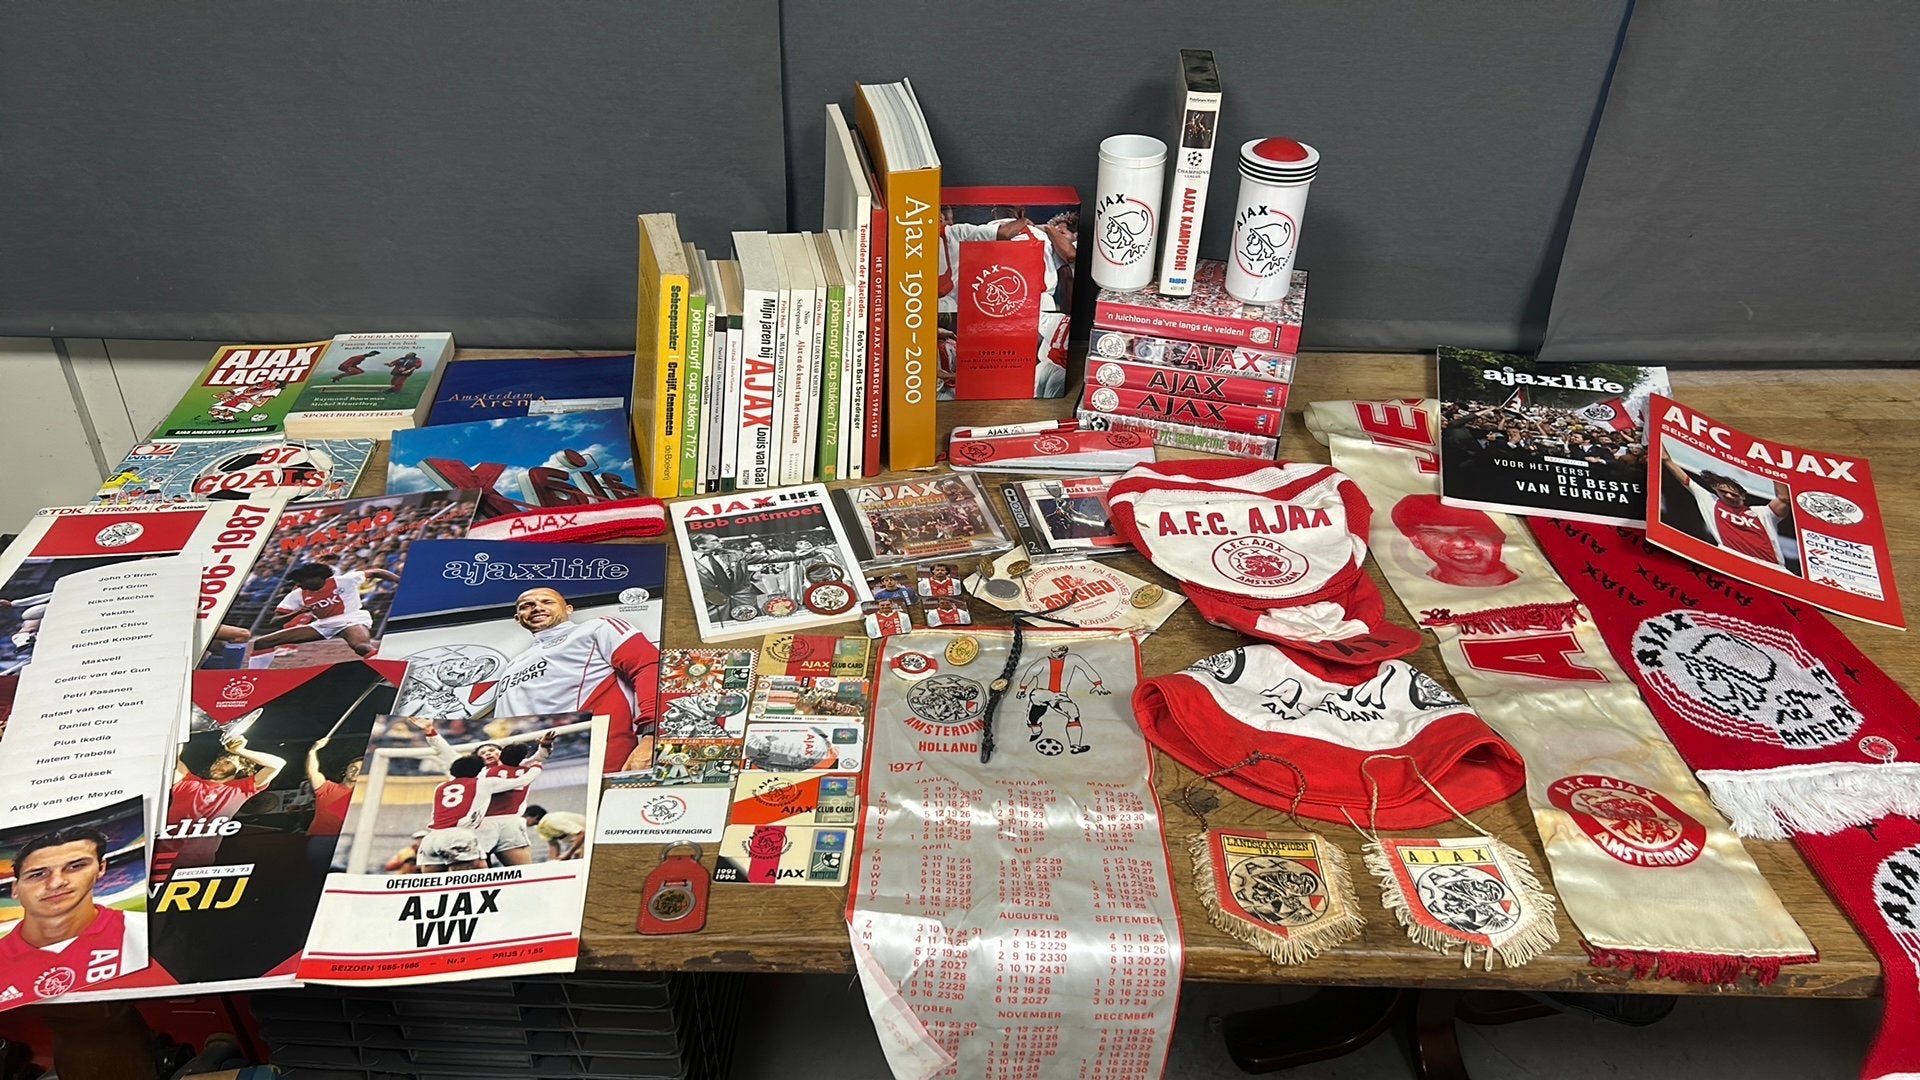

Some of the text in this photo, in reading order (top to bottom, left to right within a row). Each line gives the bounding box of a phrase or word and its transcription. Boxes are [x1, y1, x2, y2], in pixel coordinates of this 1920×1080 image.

[1097, 193, 1125, 220] AJAX
[1183, 187, 1197, 220] AJAX
[896, 195, 933, 260] Ajax
[1236, 205, 1268, 232] AJAX
[1125, 237, 1152, 266] AMSTERDAM
[1174, 220, 1194, 271] KAMPIOEN!
[1264, 249, 1293, 279] AMSTERDAM
[971, 263, 1000, 292] AJAX
[758, 298, 775, 359] Mijn jaren bij
[853, 224, 868, 430] Temidden der Ajacieden Foto's van Bart Sorgedrager
[1178, 320, 1201, 332] langs
[1202, 323, 1213, 333] de
[1214, 325, 1245, 337] velden!
[219, 346, 318, 369] AJAX
[796, 340, 805, 355] Ajax
[870, 257, 883, 438] HET OFFICIËLE AJAX JAARBOEK 1994-1995
[1181, 345, 1263, 374] AJAX
[208, 365, 309, 386] LACHT
[687, 371, 698, 391] cup
[795, 372, 803, 390] kunst
[1147, 370, 1227, 398] AJAX
[1483, 366, 1624, 394] ajaxlife
[449, 391, 533, 401] Amsterdam
[743, 358, 775, 428] AJAX
[686, 393, 697, 431] stukken
[793, 403, 801, 413] het
[1136, 394, 1228, 422] AJAX
[792, 414, 801, 444] voetballen
[987, 427, 1009, 436] AJAX
[685, 433, 697, 459] 71/72
[1661, 423, 1788, 480] SEIZOEN 1985 1986
[1663, 405, 1858, 483] AFC AJAX
[256, 447, 302, 466] 97
[755, 427, 769, 485] Louis van Gaal
[1494, 458, 1590, 477] VOOR HET EERST
[194, 468, 327, 494] GOALS
[1557, 474, 1641, 494] DE BESTE
[857, 480, 943, 504] AJAX
[1516, 480, 1629, 504] VAN EUROPA
[49, 507, 86, 515] TDK
[94, 505, 143, 513] CITROËN
[684, 489, 820, 519] AJAX LIFE
[509, 513, 577, 535] AJAX
[689, 505, 822, 532] Bob ontmoet
[1159, 510, 1238, 537] A.F.C.
[1718, 507, 1761, 530] TDK
[280, 508, 395, 551] MALMÖ
[1223, 538, 1285, 555] A.F.C. AJAX
[1819, 535, 1864, 552] TDK
[442, 552, 629, 586] ajaxlife
[1830, 555, 1872, 569] Martinair
[98, 571, 157, 583] John O'Brien
[1235, 570, 1301, 586] AMSTERDAM
[116, 593, 155, 601] Machlas
[100, 608, 135, 617] Yakubu
[80, 620, 148, 634] Cristian Chivu
[71, 633, 154, 650] Richard Knopper
[1637, 612, 1693, 669] AJAX
[81, 655, 121, 666] Maxwell
[512, 659, 547, 680] ZIGGO
[801, 660, 830, 668] AJAX
[832, 661, 847, 669] CLUB
[54, 673, 87, 684] Cedric
[111, 668, 128, 677] der
[130, 666, 151, 674] Gun
[509, 669, 547, 689] SPORT
[63, 686, 133, 700] Petri Pasanen
[40, 700, 144, 719] Rafael van der Vaart
[58, 718, 119, 731] Daniel Cruz
[904, 716, 987, 737] AMSTERDAM
[53, 734, 112, 747] Pius Ikedia
[803, 734, 815, 756] AJAX
[918, 740, 978, 753] HOLLAND
[36, 749, 117, 765] Hatem Trabelsi
[888, 760, 923, 773] 1977
[69, 768, 113, 780] Galásek
[759, 776, 779, 789] AJAX
[442, 783, 465, 808] 8
[1556, 776, 1658, 801] A.F.C. AJAX
[9, 788, 124, 813] Andy van der Meyde
[643, 794, 665, 810] AJAX
[781, 805, 854, 814] AJAX CLUB CARD
[604, 828, 713, 836] SUPPORTERSVERENIGING
[1225, 836, 1310, 852] LANDSKAMPIOEN
[1258, 848, 1281, 856] 1972
[1593, 830, 1700, 867] AMSTERDAM
[386, 869, 522, 890] OFFICIEEL PROGRAMMA
[765, 868, 804, 878] AJAX
[1238, 859, 1287, 902] AJAX
[1428, 867, 1470, 913] AJAX
[398, 888, 501, 922] AJAX
[1000, 912, 1060, 921] AUGUSTUS
[1095, 915, 1163, 925] SEPTEMBER
[415, 917, 479, 948] VVV
[331, 963, 375, 973] SEIZOEN
[377, 961, 420, 971] 1985-1986
[492, 951, 518, 960] PRIJS
[1095, 1013, 1154, 1021] DECEMBER
